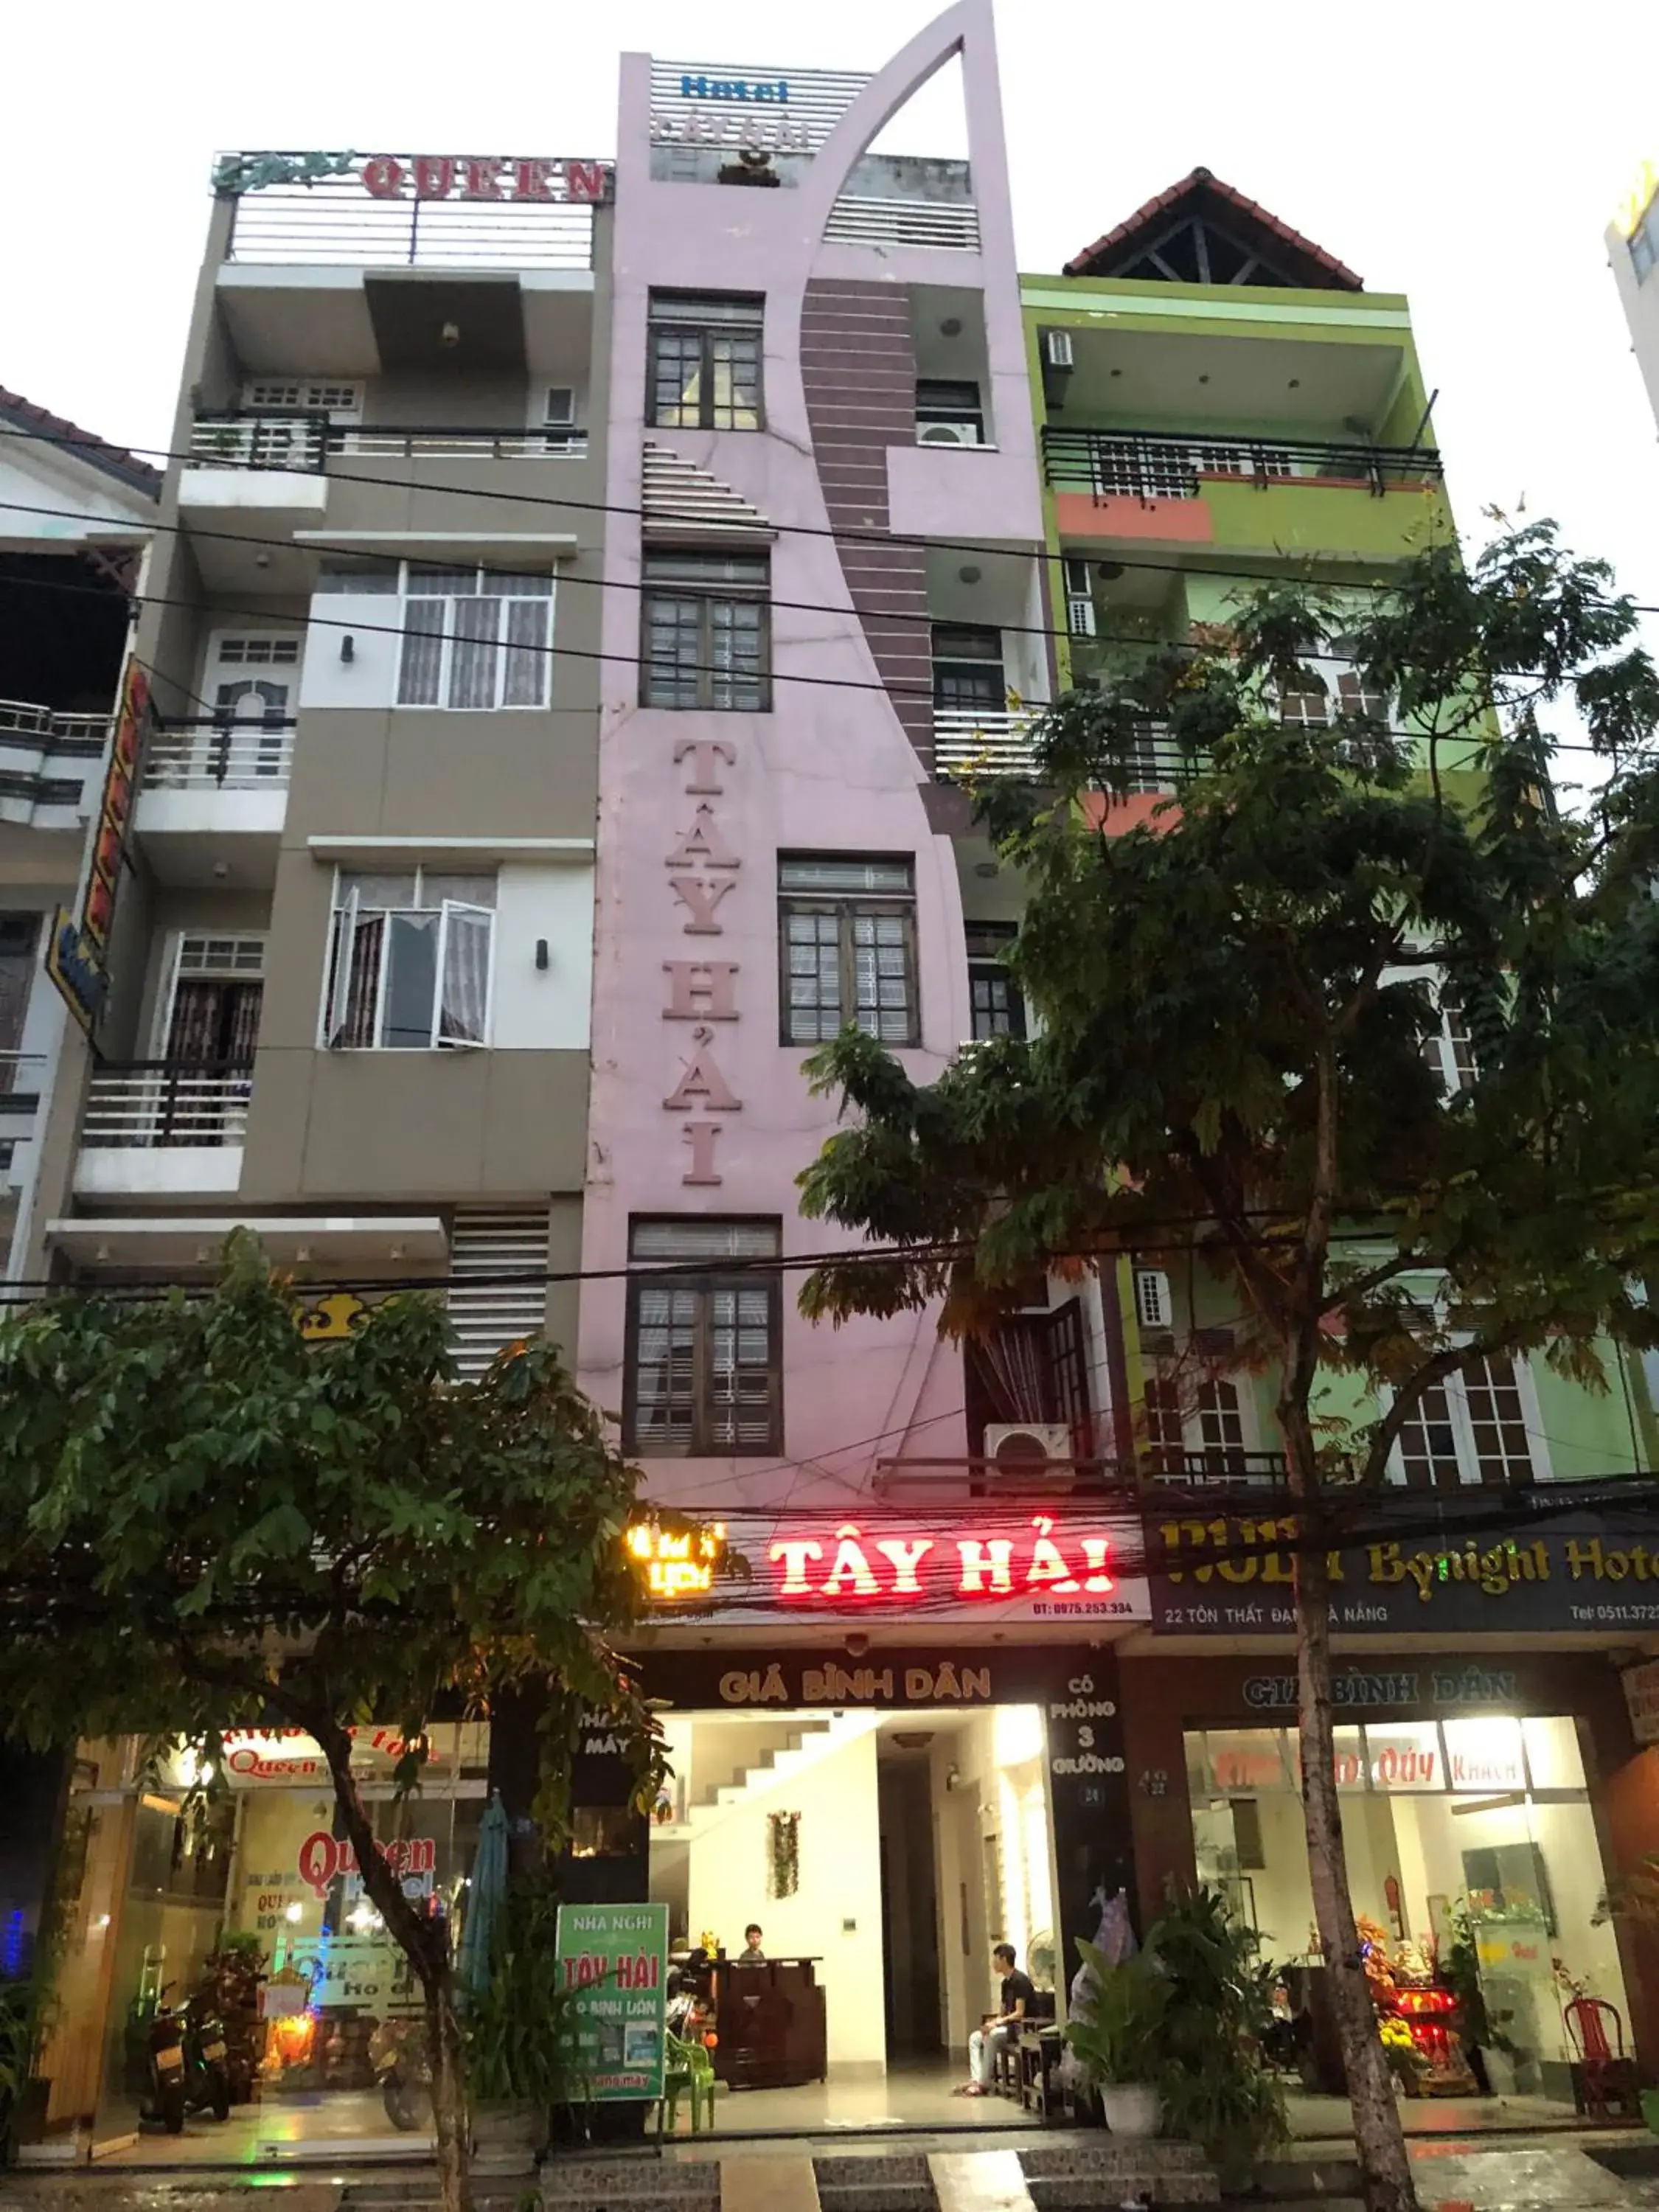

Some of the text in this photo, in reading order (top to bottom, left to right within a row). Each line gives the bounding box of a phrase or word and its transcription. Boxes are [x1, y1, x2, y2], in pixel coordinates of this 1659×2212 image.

[681, 74, 788, 103] Hotel
[361, 156, 605, 201] QUEEN
[768, 1524, 935, 1595] TÂY
[956, 1514, 1114, 1594] HẢI
[1165, 1608, 1183, 1624] 22
[1186, 1604, 1217, 1623] TÔN
[719, 1660, 991, 1702] GIÁ BÌNH DÂN
[1068, 1674, 1094, 1694] CÓ
[1242, 1674, 1299, 1708] GI
[1078, 1725, 1095, 1747] 3
[229, 1748, 316, 1779] Queen
